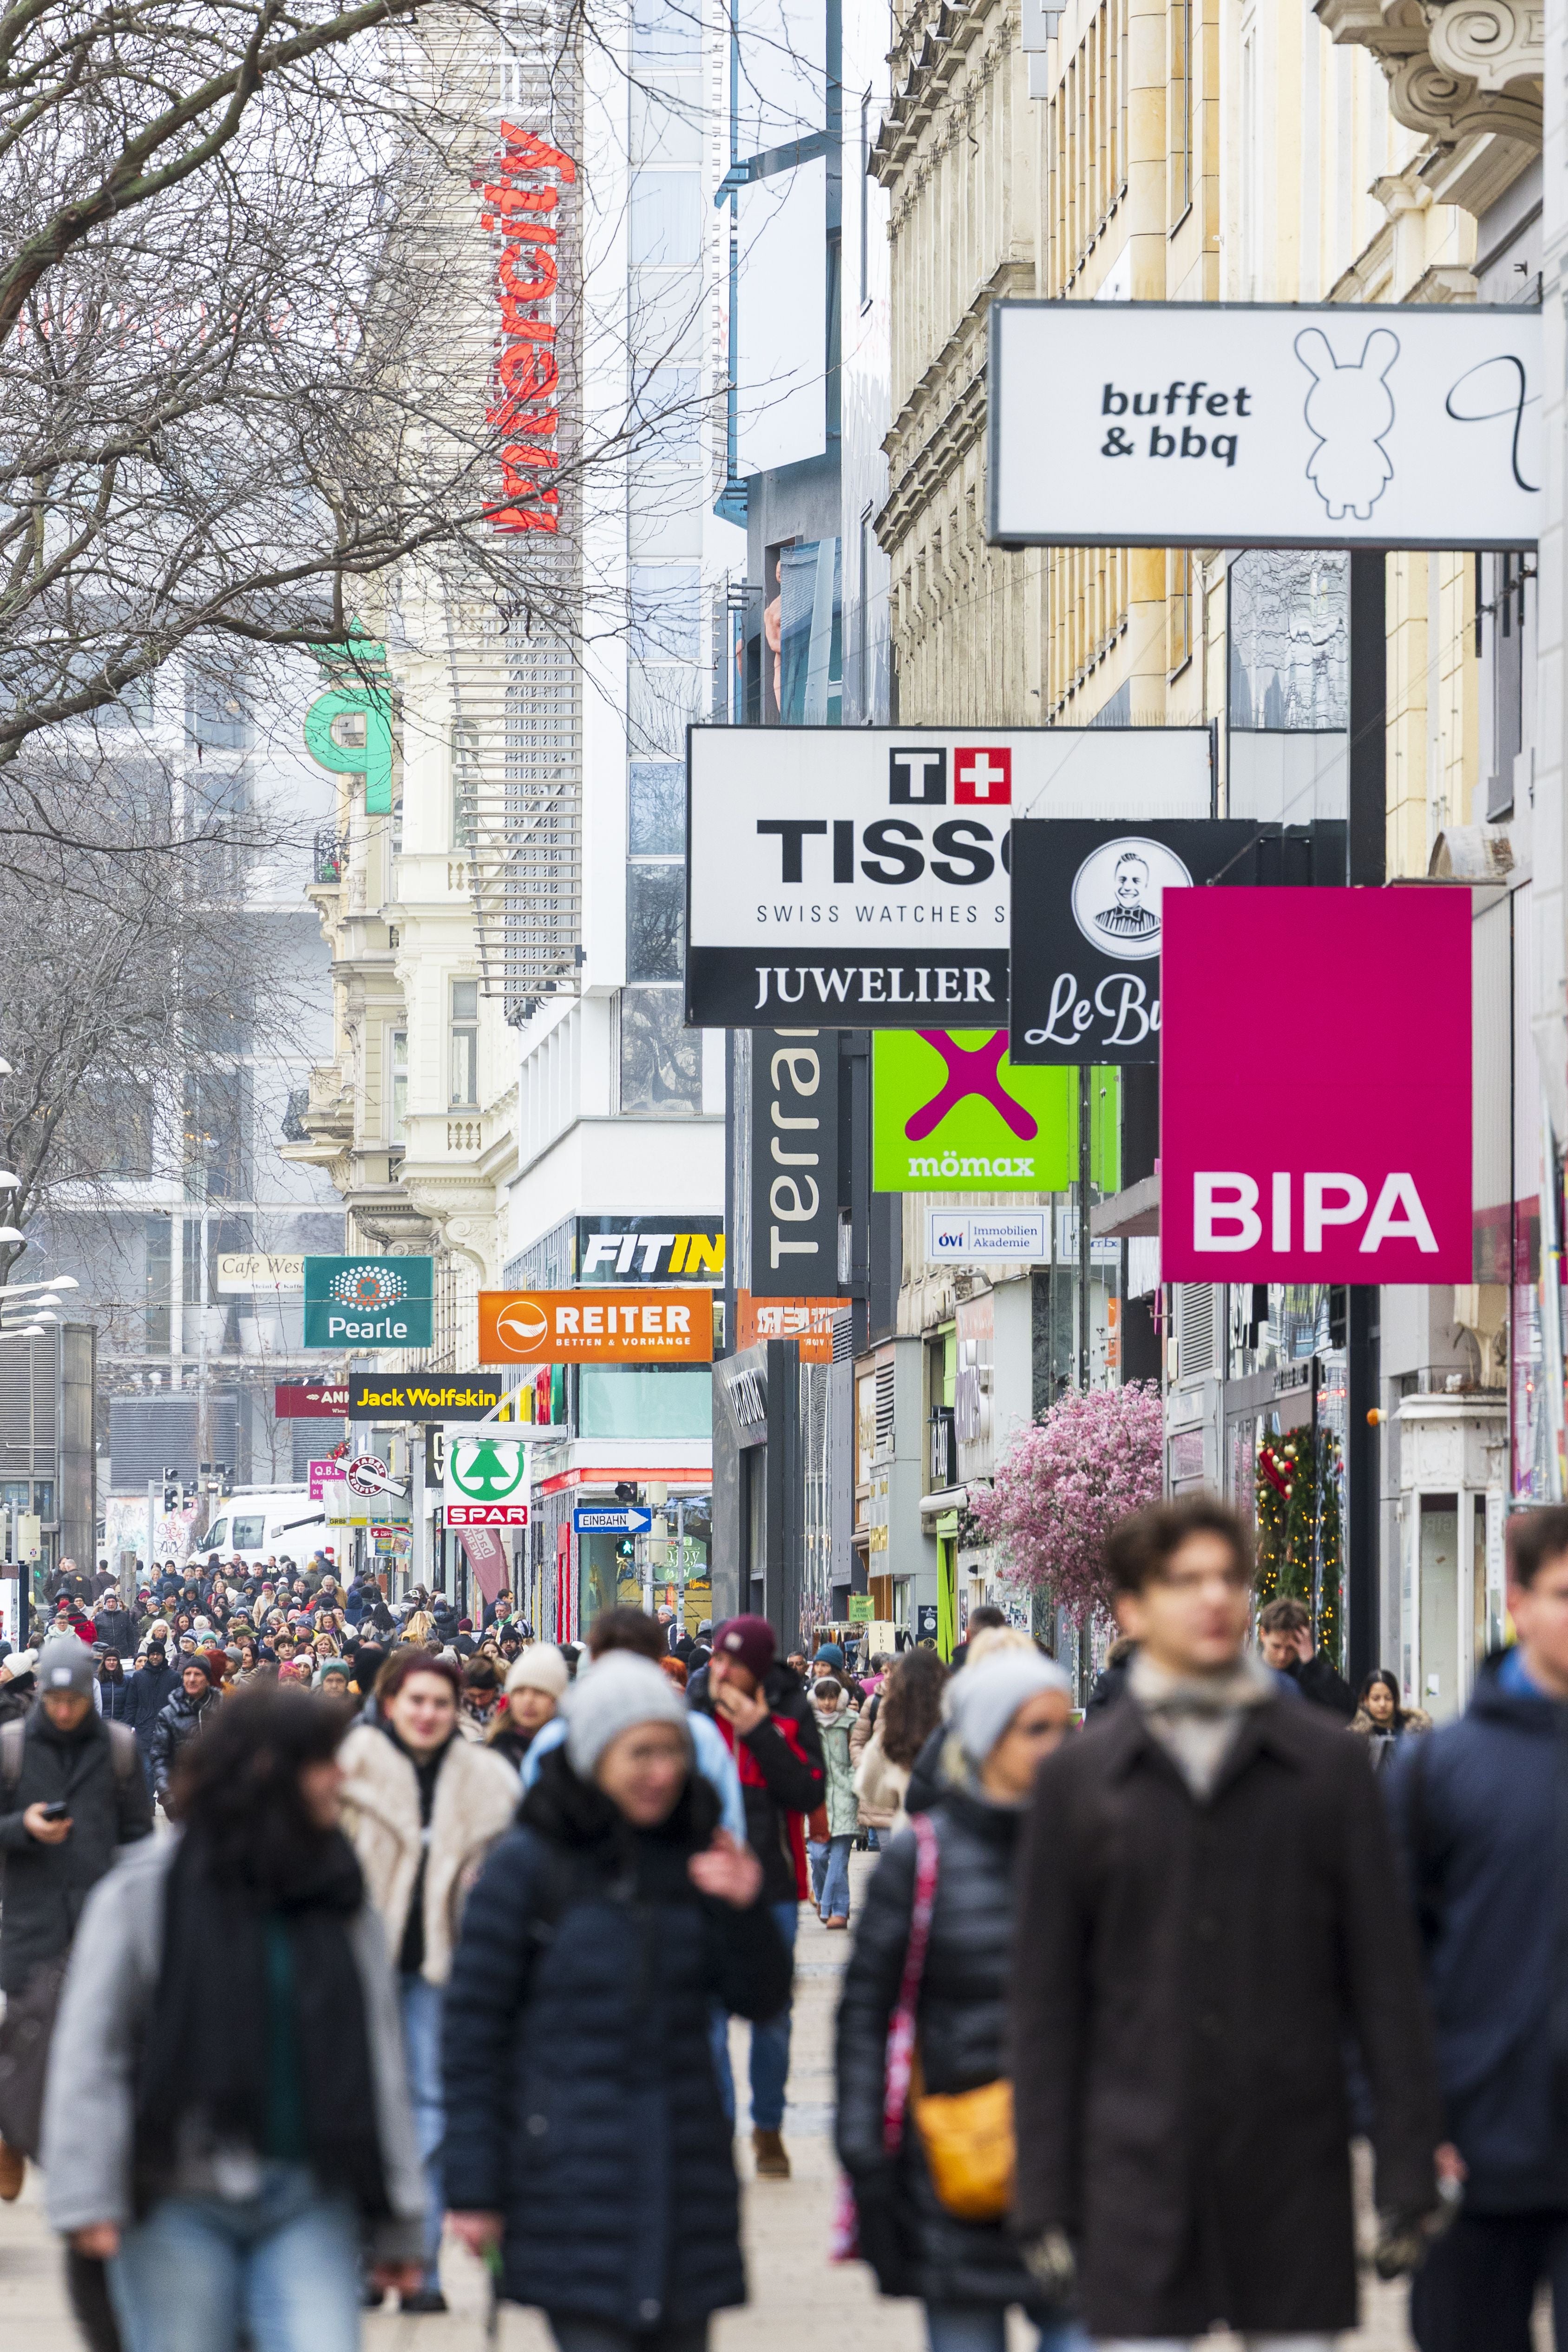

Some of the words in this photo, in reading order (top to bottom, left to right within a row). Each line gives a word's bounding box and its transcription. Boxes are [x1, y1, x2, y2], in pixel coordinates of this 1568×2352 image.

[1101, 381, 1253, 418] buffet
[1101, 426, 1136, 458] &
[1148, 425, 1239, 468] bbq
[756, 819, 1010, 885] TISS
[757, 905, 839, 923] SWISS
[855, 905, 977, 923] WATCHES
[754, 967, 994, 1010] JUWELIER
[908, 1150, 1035, 1177] mömax
[1193, 1171, 1439, 1253] BIPA
[973, 1225, 1037, 1236] Immobilien
[974, 1238, 1030, 1248] Akademie
[329, 1317, 407, 1339] Pearle
[556, 1306, 691, 1334] REITER
[556, 1338, 602, 1347] BETTEN
[622, 1335, 691, 1347] VORHÄNGE
[357, 1388, 405, 1407] Jack
[406, 1387, 496, 1407] Wolfskin
[355, 1457, 386, 1474] TABAK
[349, 1472, 377, 1494] TRAFIK
[450, 1508, 525, 1523] SPAR
[583, 1515, 627, 1526] EINBAHN
